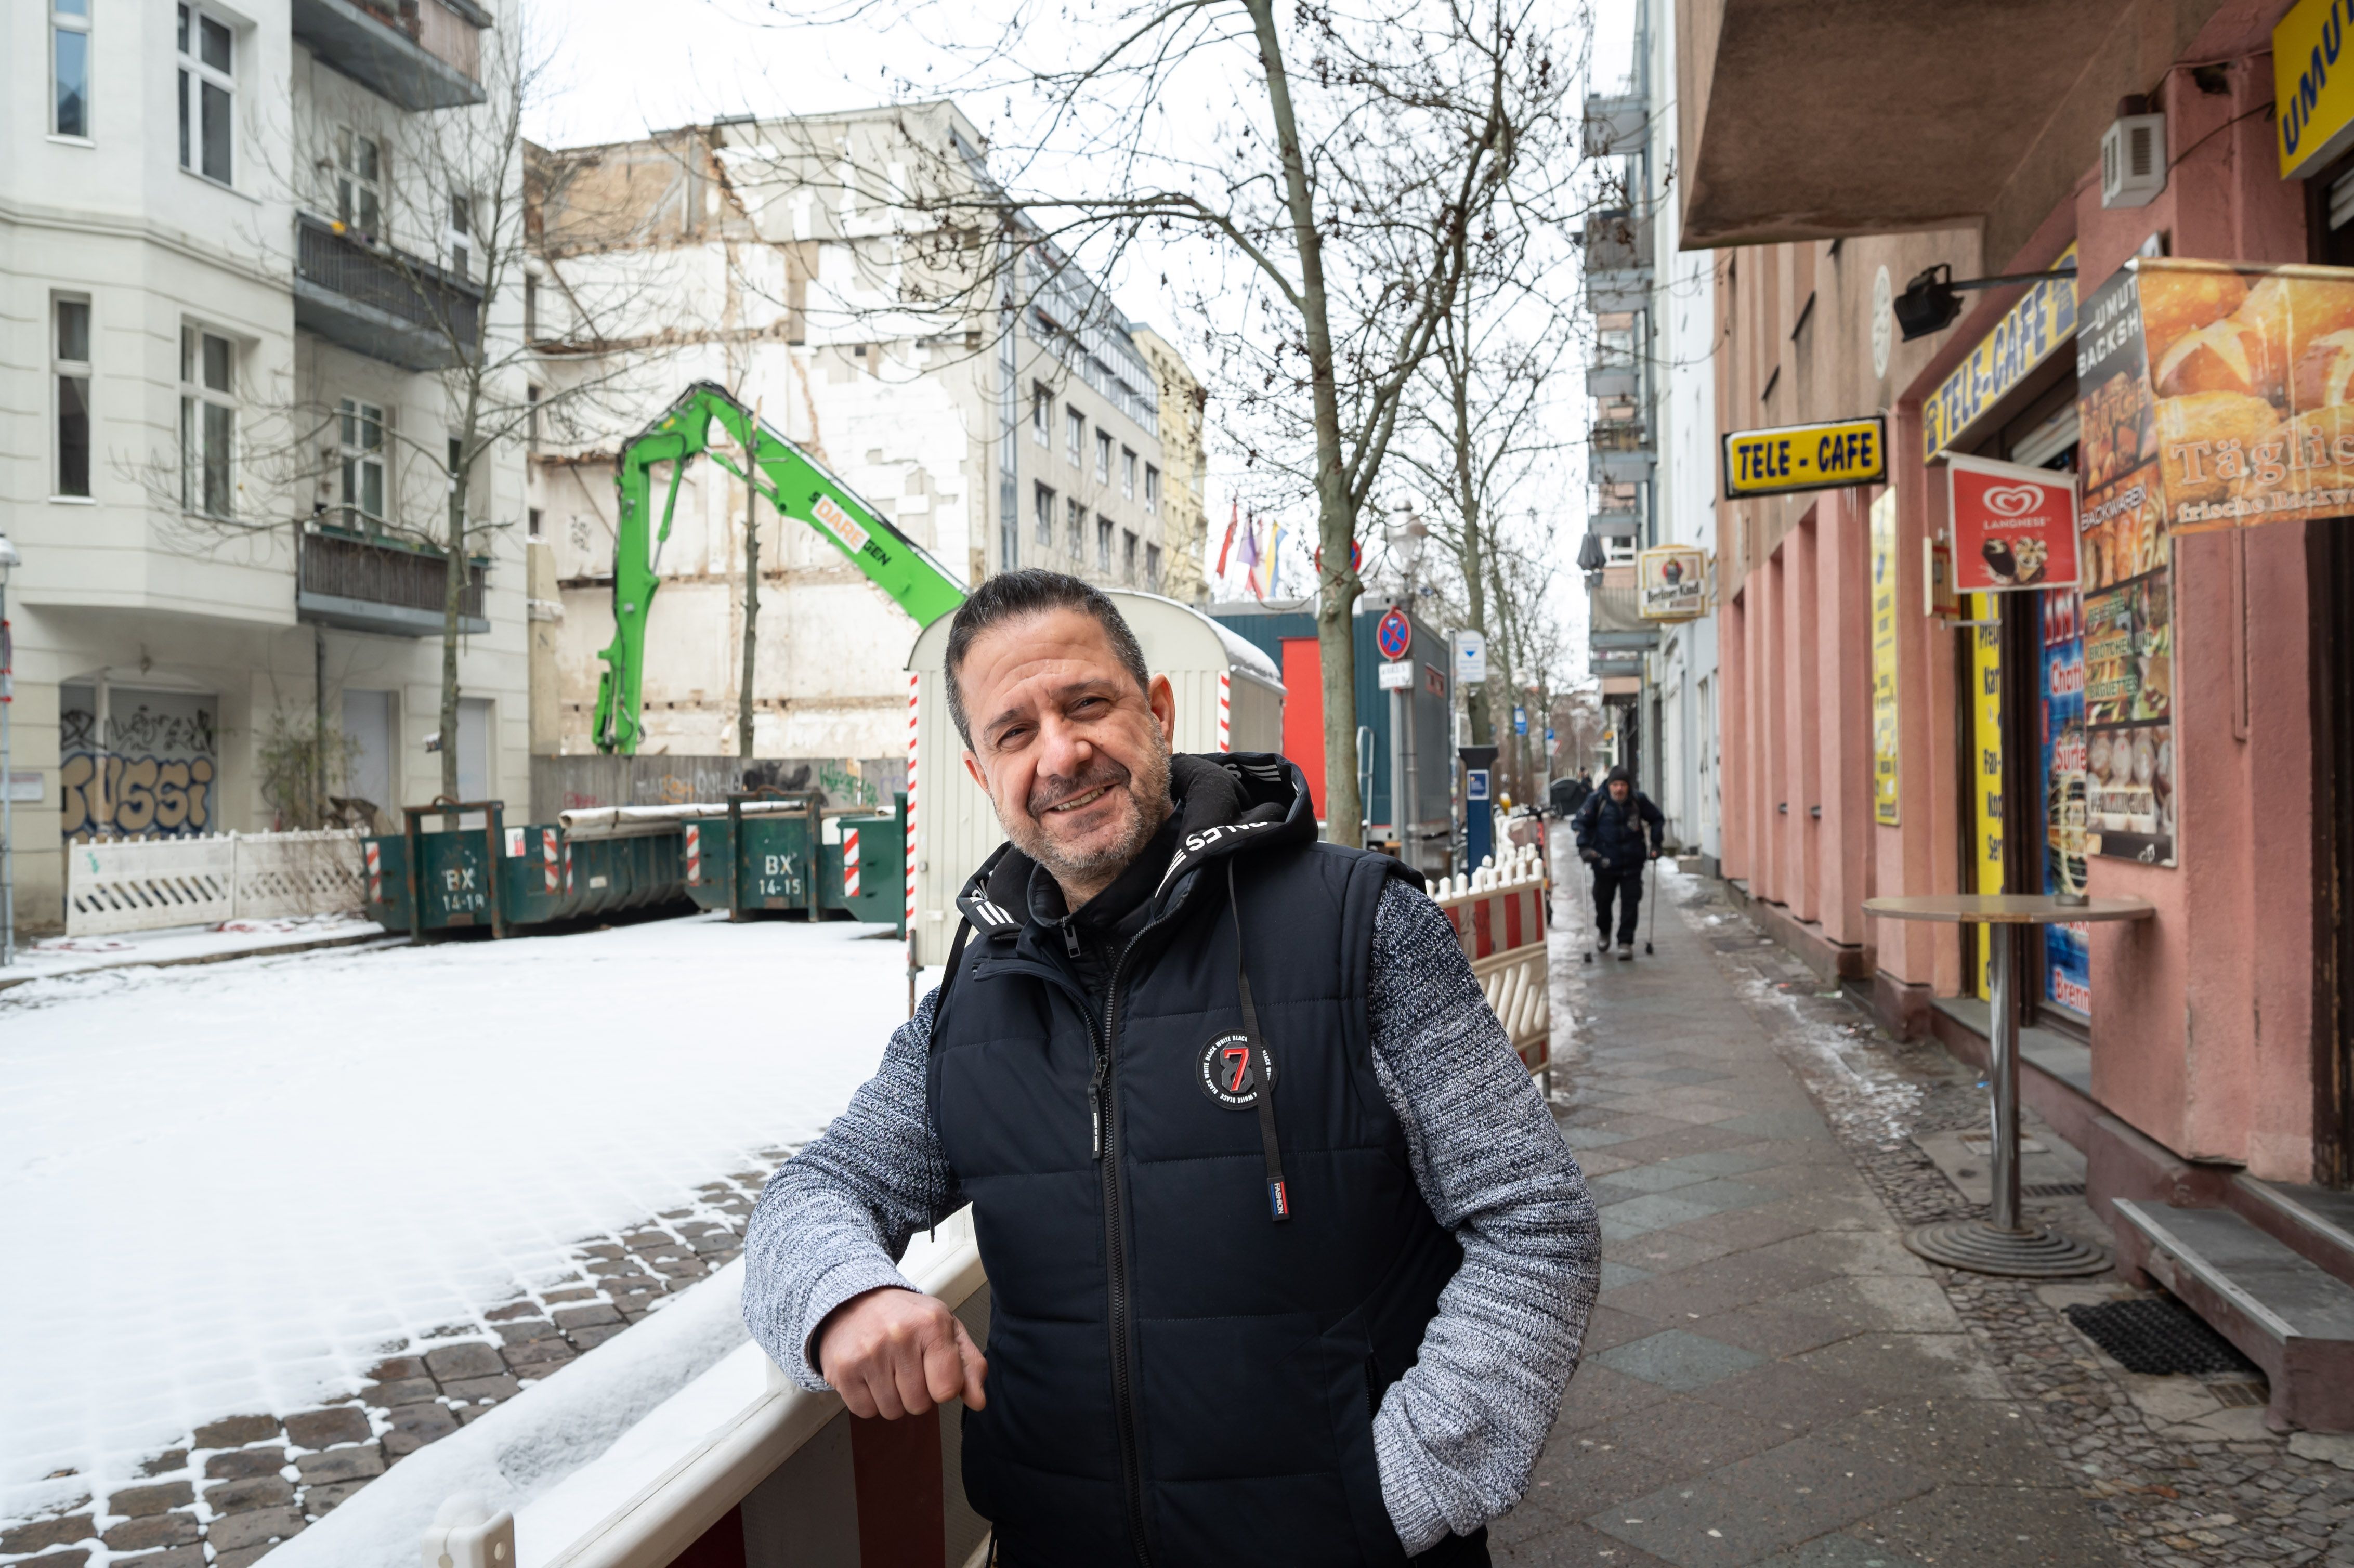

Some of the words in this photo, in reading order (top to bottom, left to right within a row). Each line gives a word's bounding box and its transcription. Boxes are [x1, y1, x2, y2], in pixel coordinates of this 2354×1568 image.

[2095, 275, 2137, 331] UMUT
[1941, 279, 2048, 446] TELE-CAFE
[1738, 441, 1790, 481] TELE
[1818, 432, 1872, 472] CAFE
[2081, 484, 2146, 533] BACKWAREN
[2178, 495, 2265, 524] frische
[816, 500, 866, 548] DARE
[2089, 636, 2131, 660] BRÖTCHEN
[2089, 674, 2139, 699] BAGUETTES
[765, 854, 794, 876] BX
[446, 868, 475, 891] BX
[759, 878, 801, 895] 14-15
[1205, 1046, 1217, 1061] BLACK
[1215, 1036, 1231, 1047] WHITE
[1206, 1079, 1219, 1094] BLACK
[1220, 1093, 1235, 1103] BLACK
[1237, 1093, 1254, 1103] WHITE
[1274, 1183, 1284, 1214] FASHION
